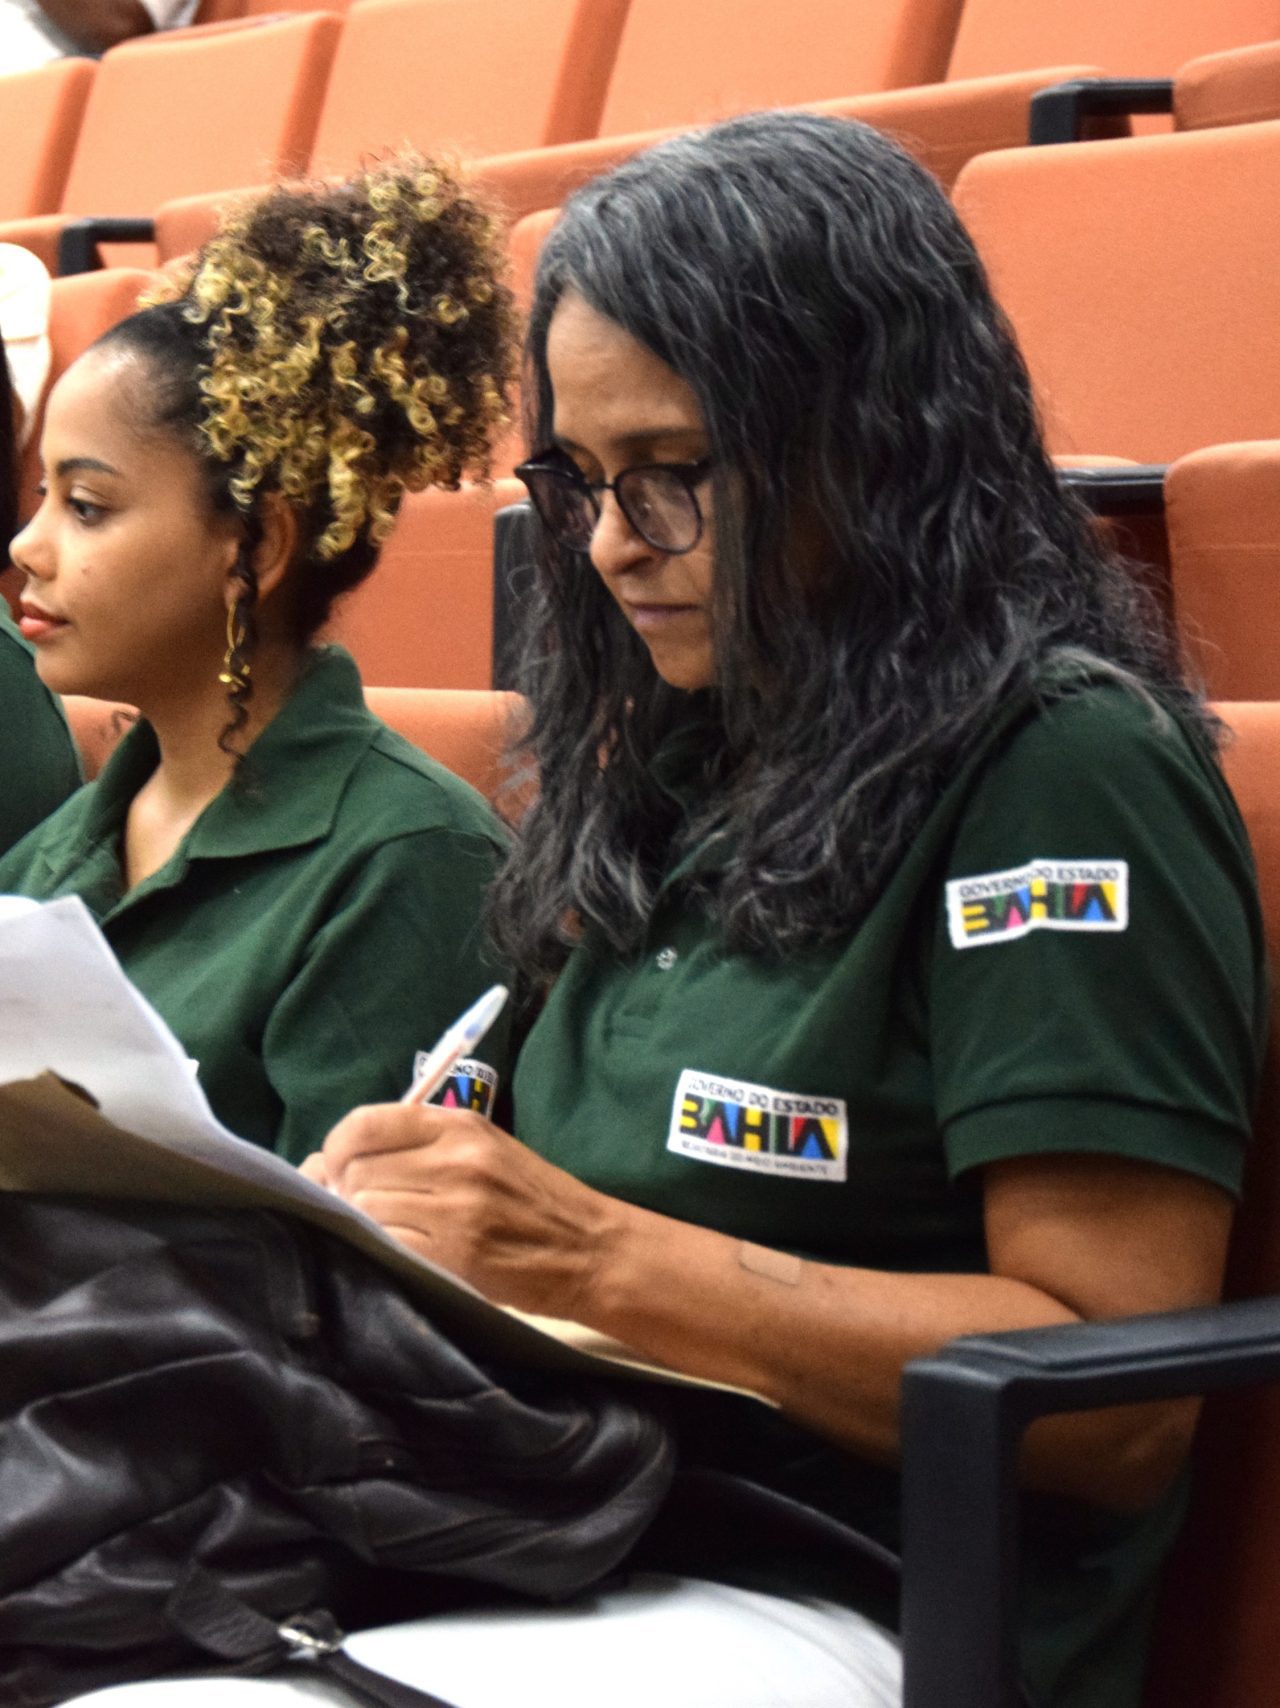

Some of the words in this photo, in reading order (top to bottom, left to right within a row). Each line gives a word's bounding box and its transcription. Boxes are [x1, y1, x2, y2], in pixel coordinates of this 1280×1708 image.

[959, 872, 1032, 898] GOVERNO
[1057, 866, 1119, 881] ESTADO
[961, 880, 1119, 938] BAHIA
[679, 1093, 841, 1160] BAHIA
[748, 1092, 769, 1109] DO
[773, 1096, 839, 1116] ESTADO
